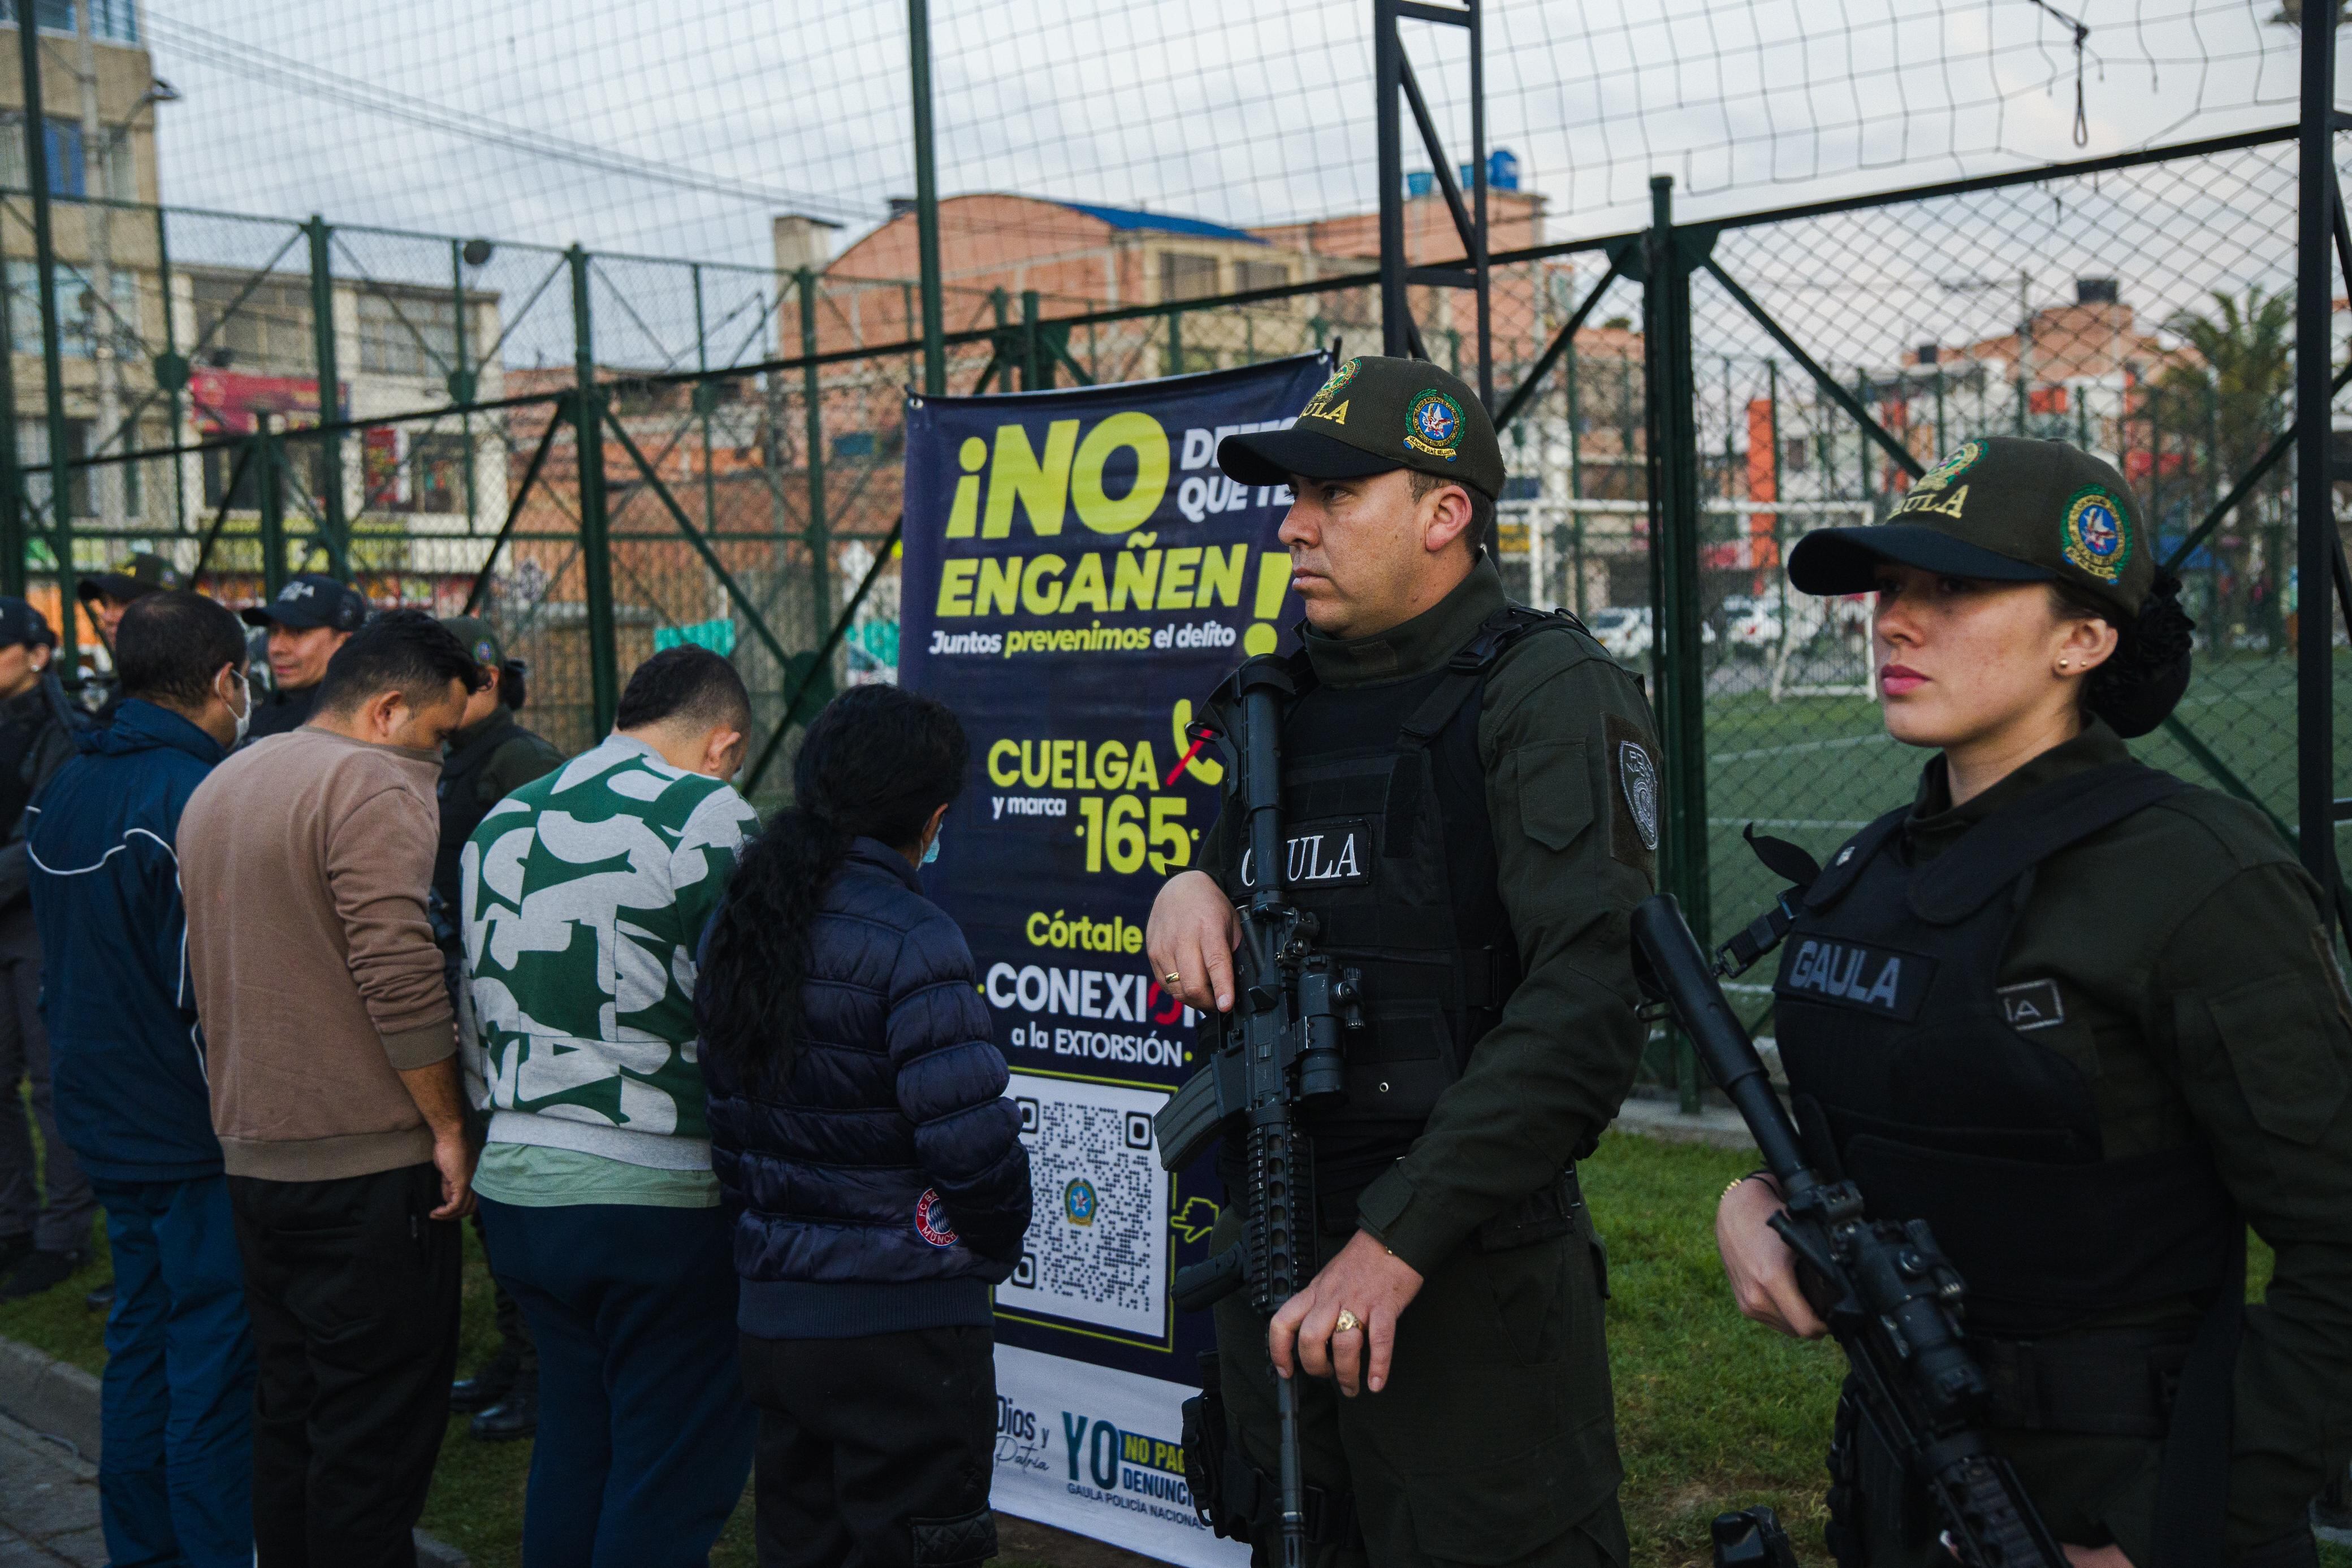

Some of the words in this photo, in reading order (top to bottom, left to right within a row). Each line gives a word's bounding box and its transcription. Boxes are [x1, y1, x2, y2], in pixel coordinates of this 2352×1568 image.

[1299, 399, 1350, 425] ULA
[945, 412, 1170, 539] ¡NO
[1178, 477, 1248, 523] QUE
[929, 629, 1002, 656] Juntos
[1004, 620, 1151, 659] prevenimos
[1154, 623, 1174, 648] el
[1176, 621, 1236, 648] delito
[987, 738, 1160, 791] CUELGA
[991, 798, 1005, 820] y
[1008, 796, 1067, 817] marca
[1080, 794, 1191, 876] 165
[1026, 908, 1143, 954] Córtale
[1789, 940, 1901, 1008] GAULA
[1011, 1028, 1026, 1046] a
[1030, 1021, 1049, 1049] la
[1054, 1028, 1182, 1068] EXTORSIÓN
[919, 1203, 927, 1217] FC
[924, 1191, 938, 1202] BA
[922, 1225, 957, 1244] MÜNCH
[997, 1394, 1036, 1441] Dios
[1041, 1428, 1050, 1448] y
[995, 1436, 1050, 1472] Patria
[1062, 1410, 1119, 1491] YO
[1123, 1434, 1150, 1465] NO
[1067, 1482, 1102, 1504] GAULA
[1104, 1492, 1148, 1514] POLICÍA
